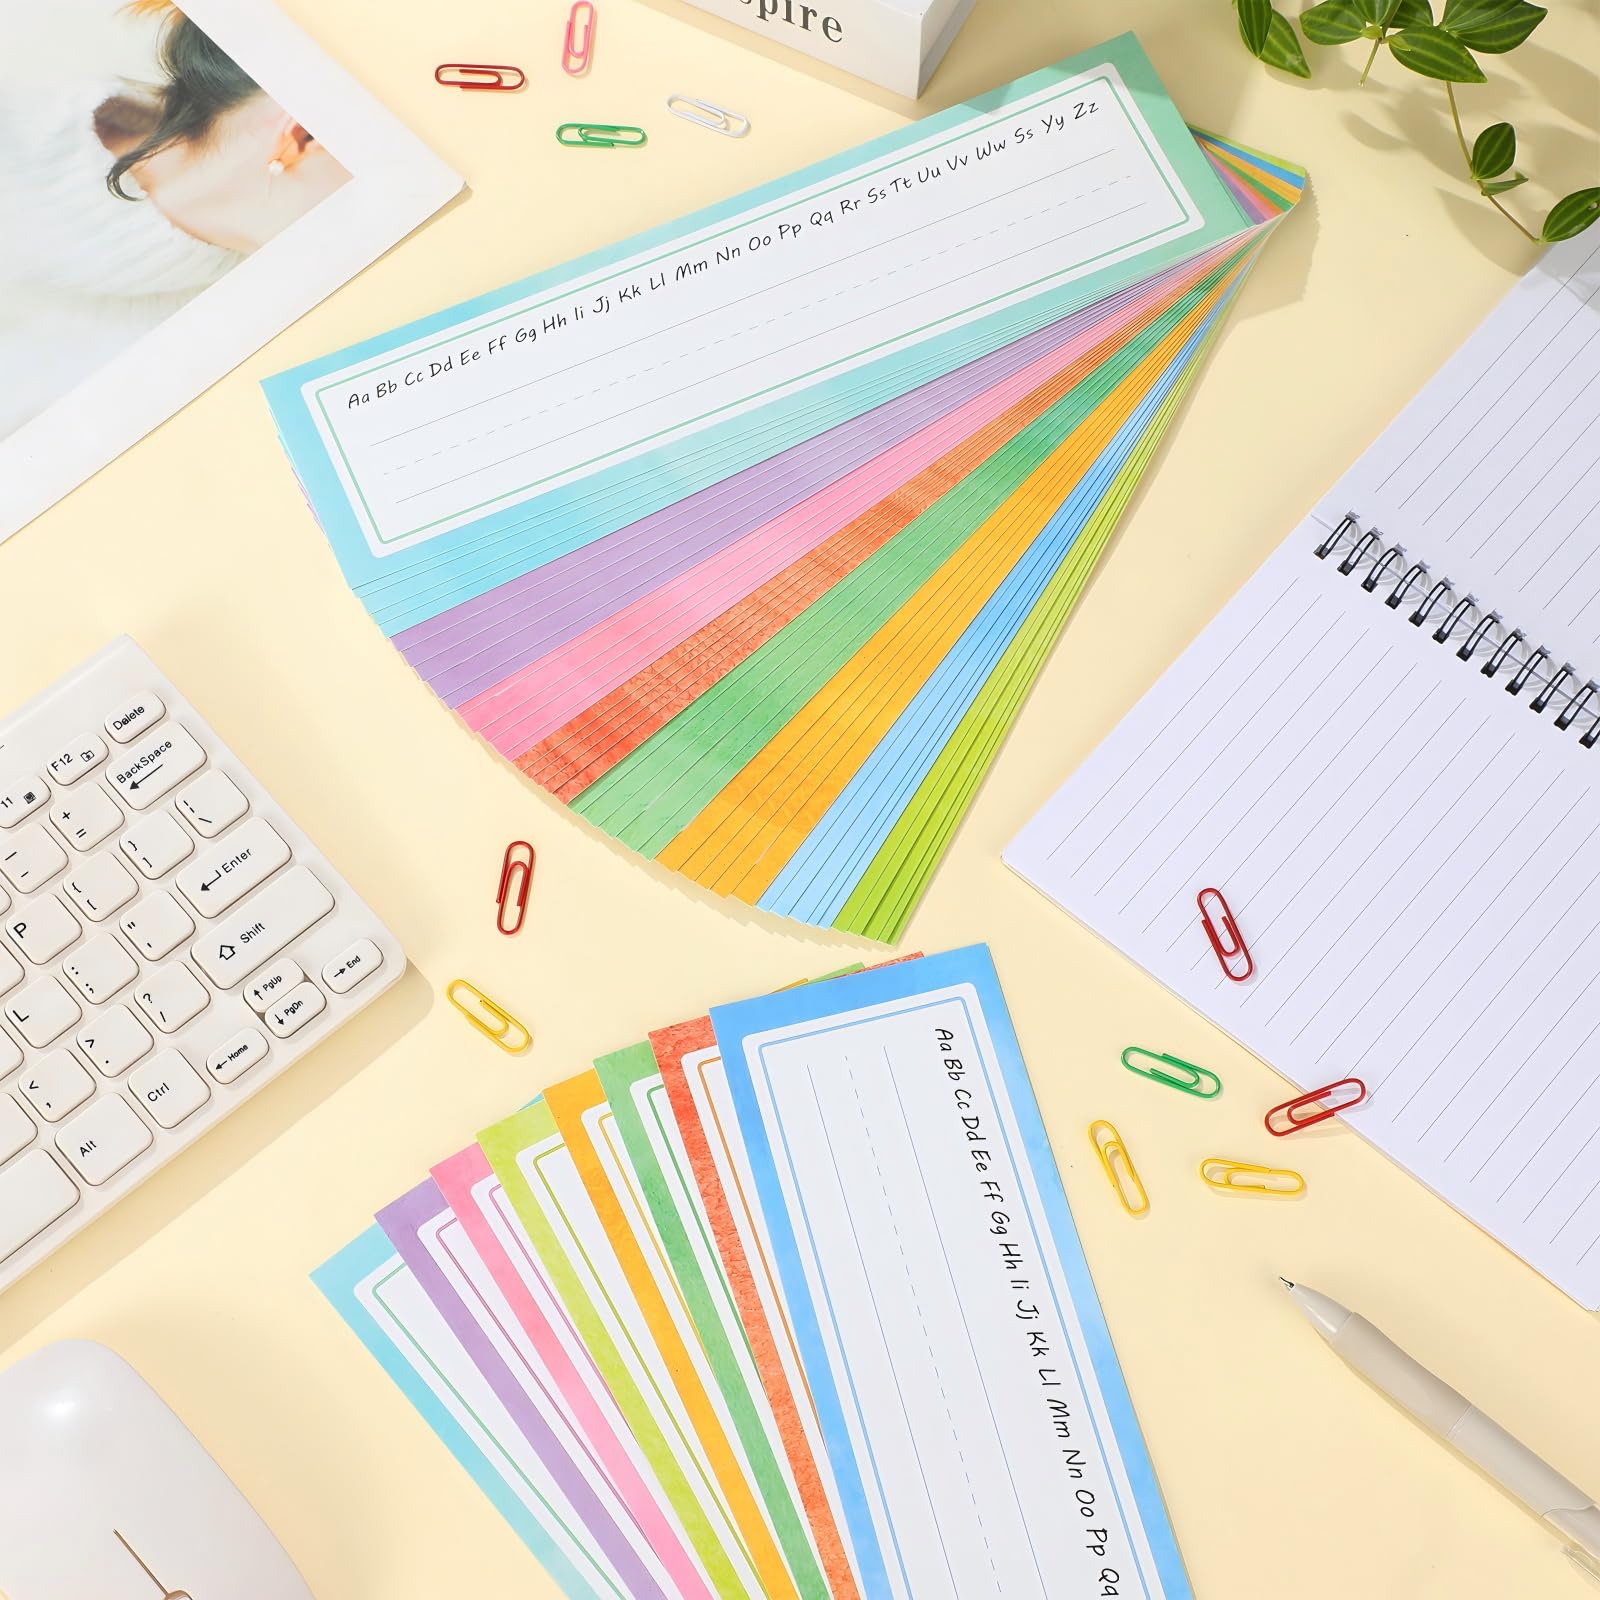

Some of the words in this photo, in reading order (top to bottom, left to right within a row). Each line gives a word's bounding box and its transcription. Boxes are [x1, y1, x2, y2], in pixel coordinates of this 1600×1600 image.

[740, 0, 842, 42] pire
[348, 392, 371, 410] Aa
[375, 379, 398, 399] Bb
[404, 371, 424, 387] Cc
[428, 355, 454, 378] Dd
[460, 348, 481, 366] Ee
[488, 334, 508, 356] Ff
[514, 327, 537, 343] Gg
[542, 313, 567, 335] Hh
[592, 295, 610, 314] Jj
[618, 284, 642, 304] Kk
[675, 260, 708, 282] Mm
[716, 246, 741, 265] Nn
[748, 235, 772, 252] Oo
[777, 223, 802, 240] Pp
[809, 210, 834, 227] Qq
[839, 199, 862, 215] Rr
[867, 187, 887, 204] Ss
[889, 177, 913, 193] Tt
[917, 166, 942, 184] Uu
[945, 154, 969, 171] Vv
[975, 139, 1006, 161] Ww
[1014, 127, 1034, 144] Ss
[1040, 114, 1065, 134] Yy
[1072, 101, 1100, 120] Zz
[112, 706, 145, 731] Delete
[50, 753, 74, 772] F12
[115, 739, 173, 785] BackSpace
[221, 848, 252, 874] Enter
[12, 921, 27, 940] P
[239, 922, 266, 944] Shift
[345, 954, 361, 969] End
[262, 975, 283, 992] PgUp
[12, 1009, 30, 1023] L
[283, 1000, 304, 1017] PgDn
[934, 1028, 955, 1052] Aa
[227, 1044, 249, 1062] Home
[943, 1058, 966, 1081] Bb
[147, 1081, 170, 1102] Ctrl
[954, 1088, 973, 1110] Cc
[960, 1115, 987, 1142] Dd
[79, 1140, 97, 1158] Alt
[970, 1149, 992, 1173] Ee
[979, 1180, 1005, 1203] Ff
[989, 1210, 1011, 1235] Gg
[998, 1243, 1024, 1270] Hh
[1015, 1299, 1040, 1320] Jj
[1026, 1331, 1050, 1358] Kk
[1046, 1398, 1071, 1438] Mm
[1061, 1449, 1087, 1479] Nn
[1074, 1489, 1096, 1518] Oo
[1085, 1527, 1108, 1557] Pp
[1097, 1567, 1120, 1597] Qq
